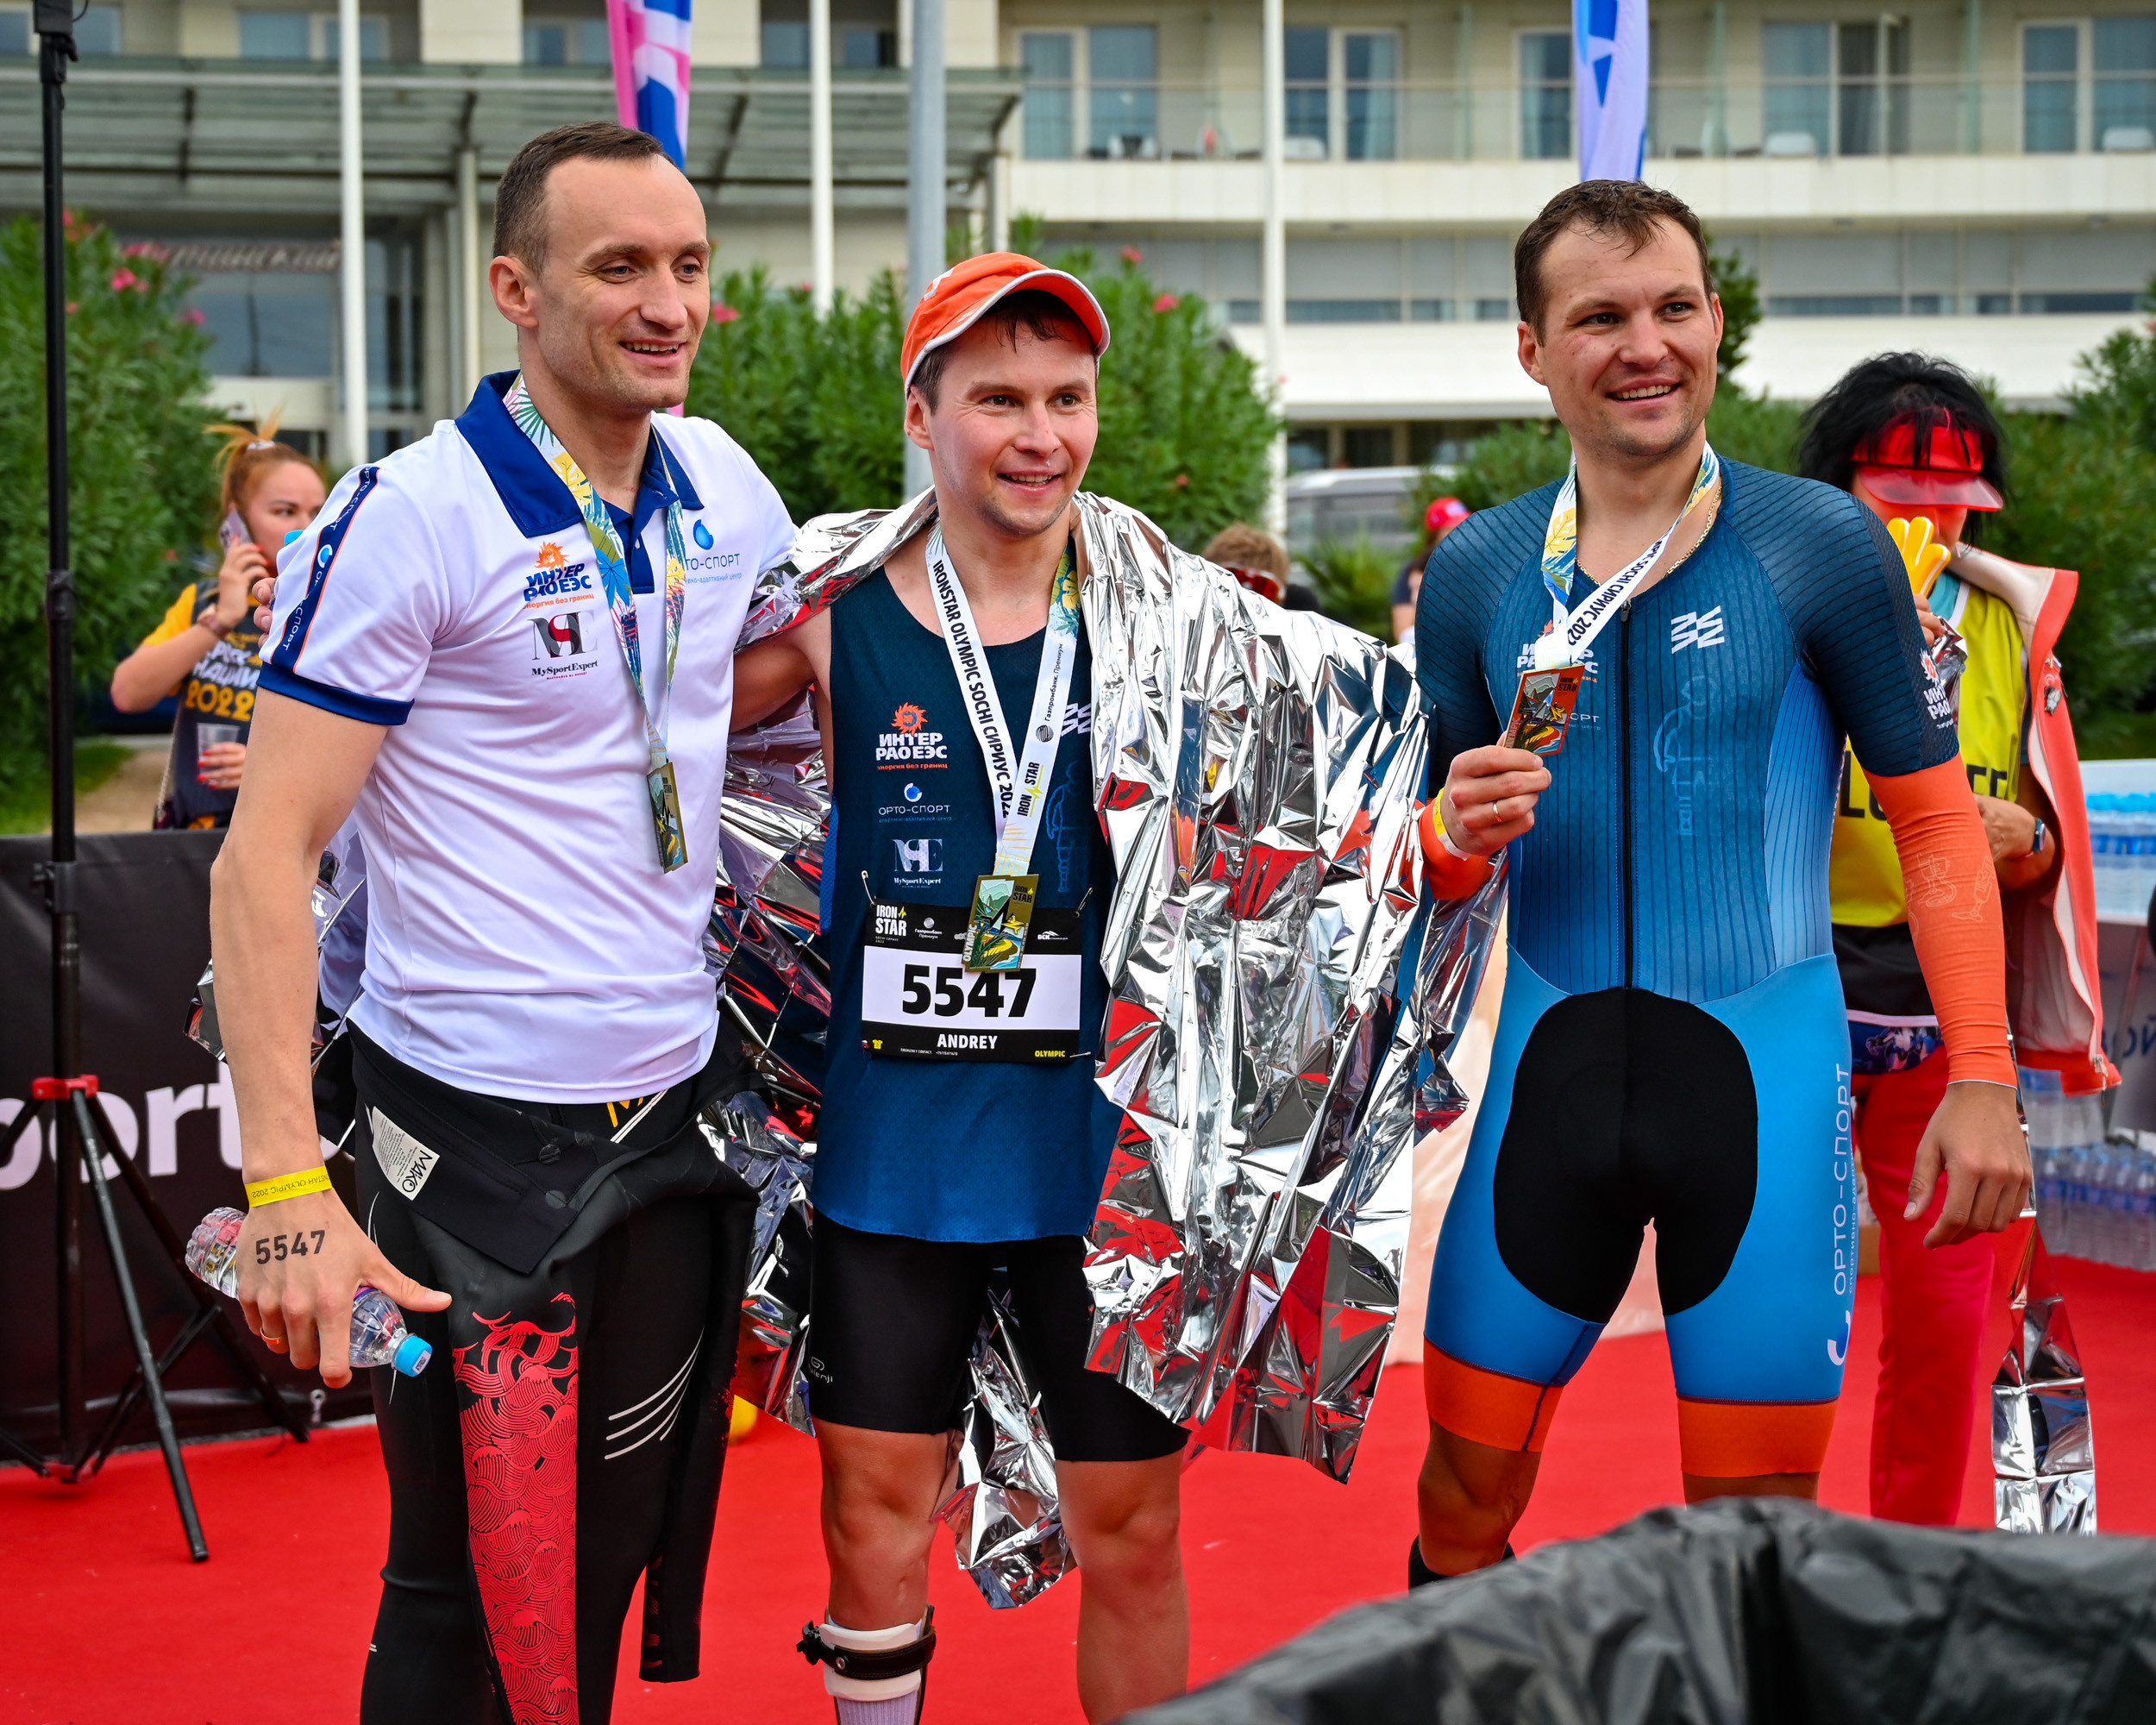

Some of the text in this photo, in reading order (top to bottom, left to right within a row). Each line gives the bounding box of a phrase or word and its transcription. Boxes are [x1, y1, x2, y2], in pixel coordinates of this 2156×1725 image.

[686, 554, 740, 570] ТО-СПОРТ
[1583, 584, 1624, 620] СИРИУС
[531, 661, 598, 676] MySportExpert
[932, 560, 961, 622] IRONSTAR
[950, 622, 981, 681] OLYMPIC
[968, 682, 994, 724] SOCHI
[985, 725, 1011, 781] СИРИУС
[1557, 683, 1577, 692] STAR
[185, 679, 255, 722] 2022
[879, 732, 943, 747] ИНТЕР
[1017, 762, 1040, 817] IRON STAR
[878, 805, 950, 816] ОРТО-СПОРТ
[893, 877, 942, 886] MySportExpert
[1015, 885, 1028, 894] IRON
[1012, 892, 1033, 904] STAR
[876, 904, 898, 919] IRON
[874, 917, 907, 937] STAR
[962, 924, 978, 962] OLYMPIC
[902, 963, 1037, 1018] 5547
[937, 1033, 998, 1050] ANDREY
[1035, 1050, 1066, 1058] OLYMPIC
[270, 1179, 307, 1195] OLYMPIC
[1833, 1063, 1850, 1295] ОРТО-СПОРТ
[252, 1188, 269, 1198] 2022
[255, 1229, 326, 1264] 5547
